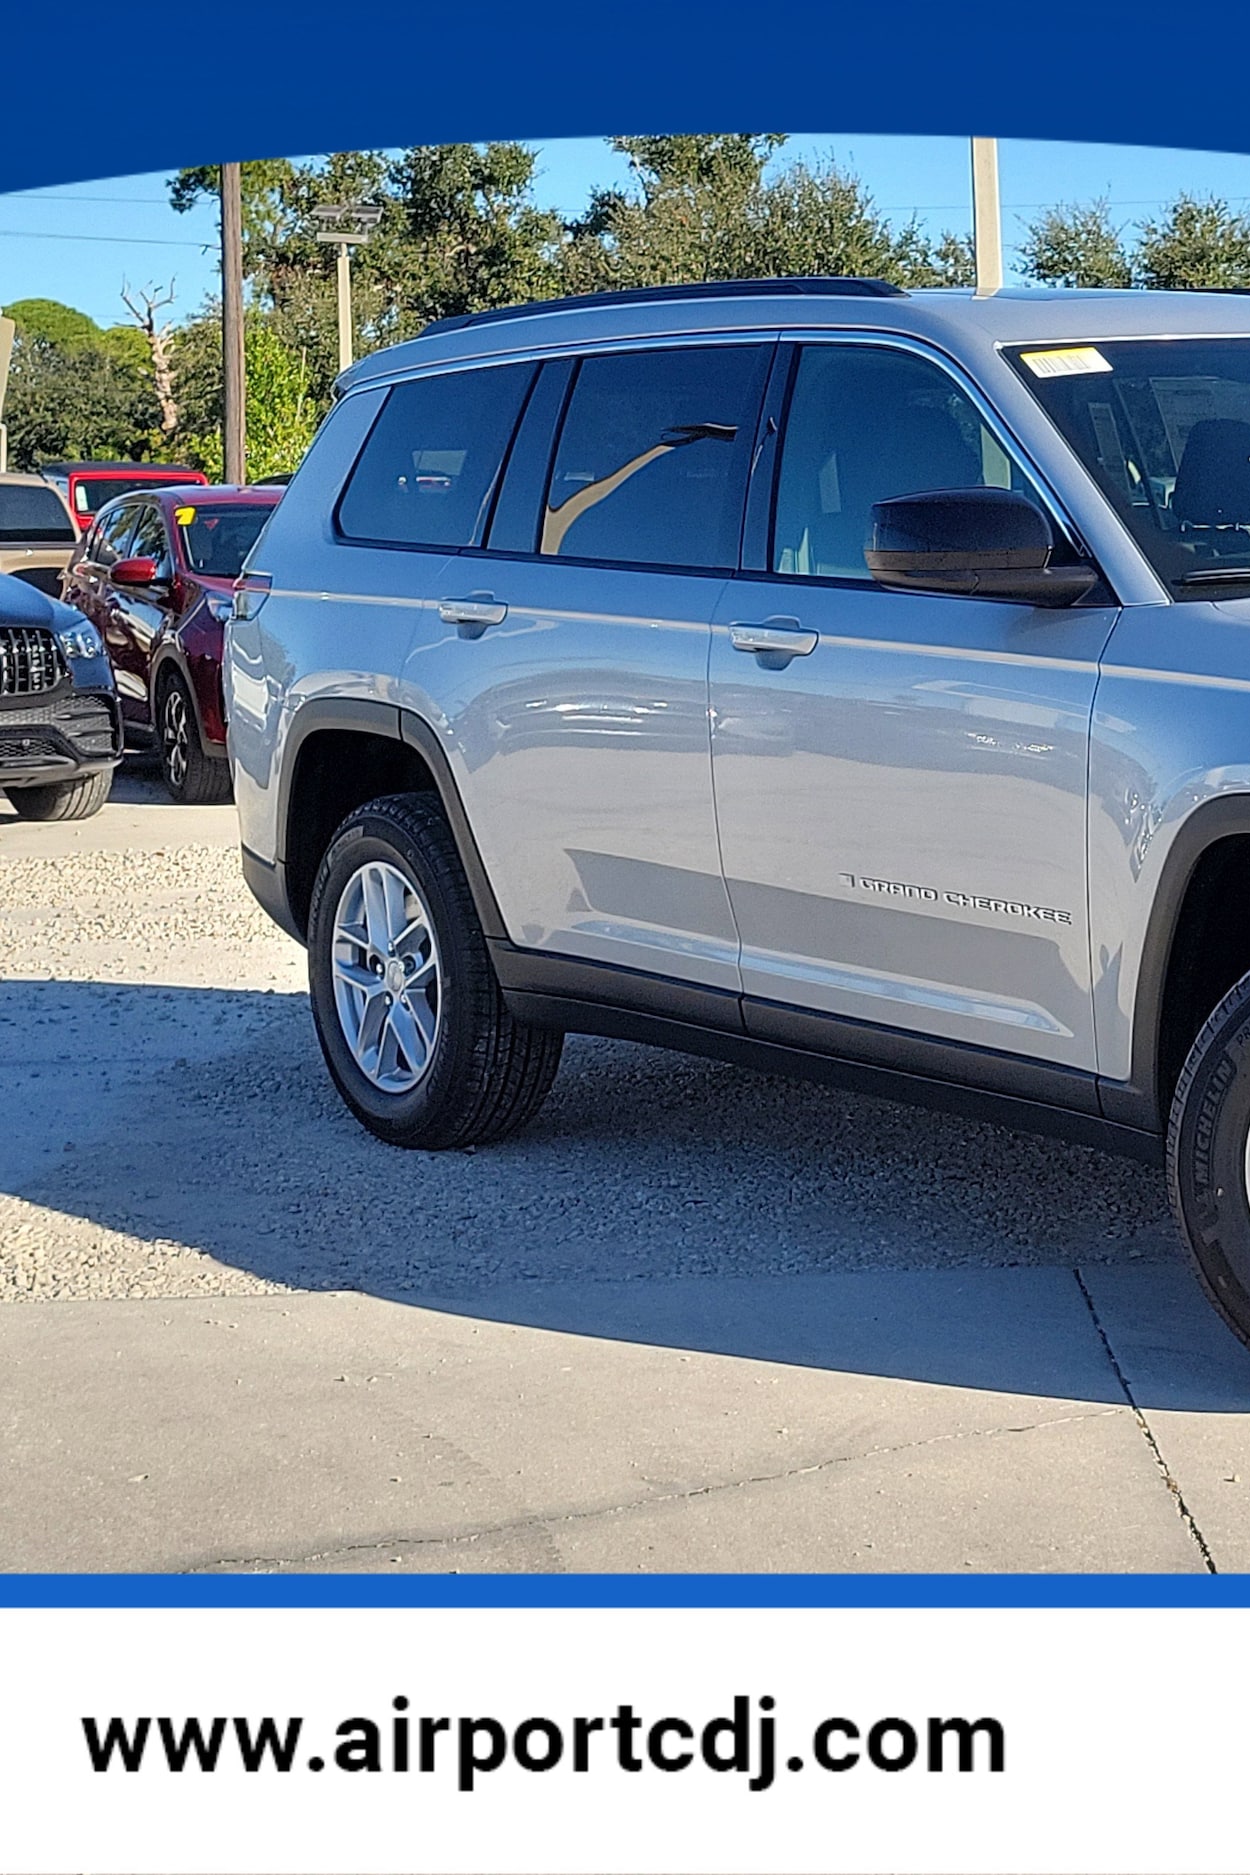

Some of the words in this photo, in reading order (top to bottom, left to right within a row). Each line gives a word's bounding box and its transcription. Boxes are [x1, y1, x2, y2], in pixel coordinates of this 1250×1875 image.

[860, 876, 939, 901] GRAND
[943, 890, 1072, 926] CHEROKEE
[1193, 1057, 1234, 1187] MICHELIN
